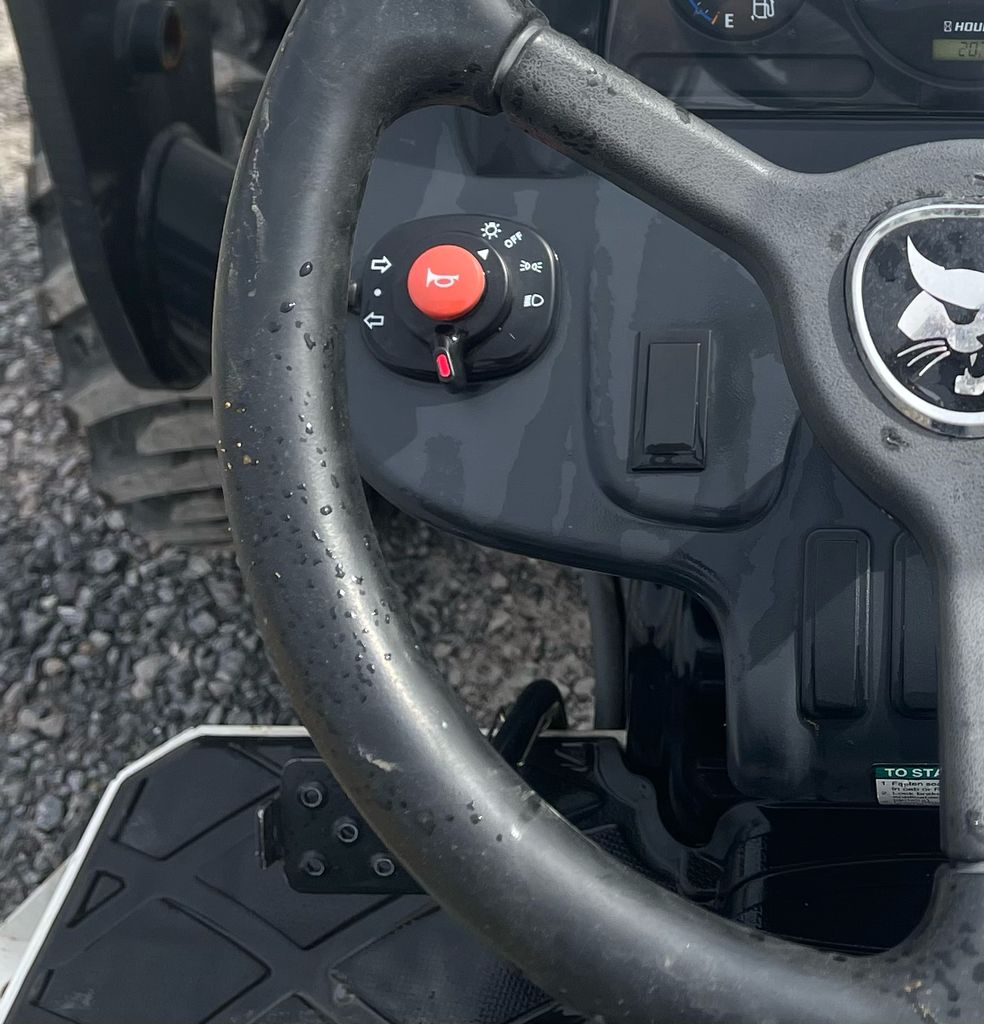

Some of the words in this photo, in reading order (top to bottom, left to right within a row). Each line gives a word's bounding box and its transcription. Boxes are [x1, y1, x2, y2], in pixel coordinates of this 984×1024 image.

[724, 14, 734, 27] E
[504, 231, 523, 249] OFF
[884, 768, 907, 777] TO
